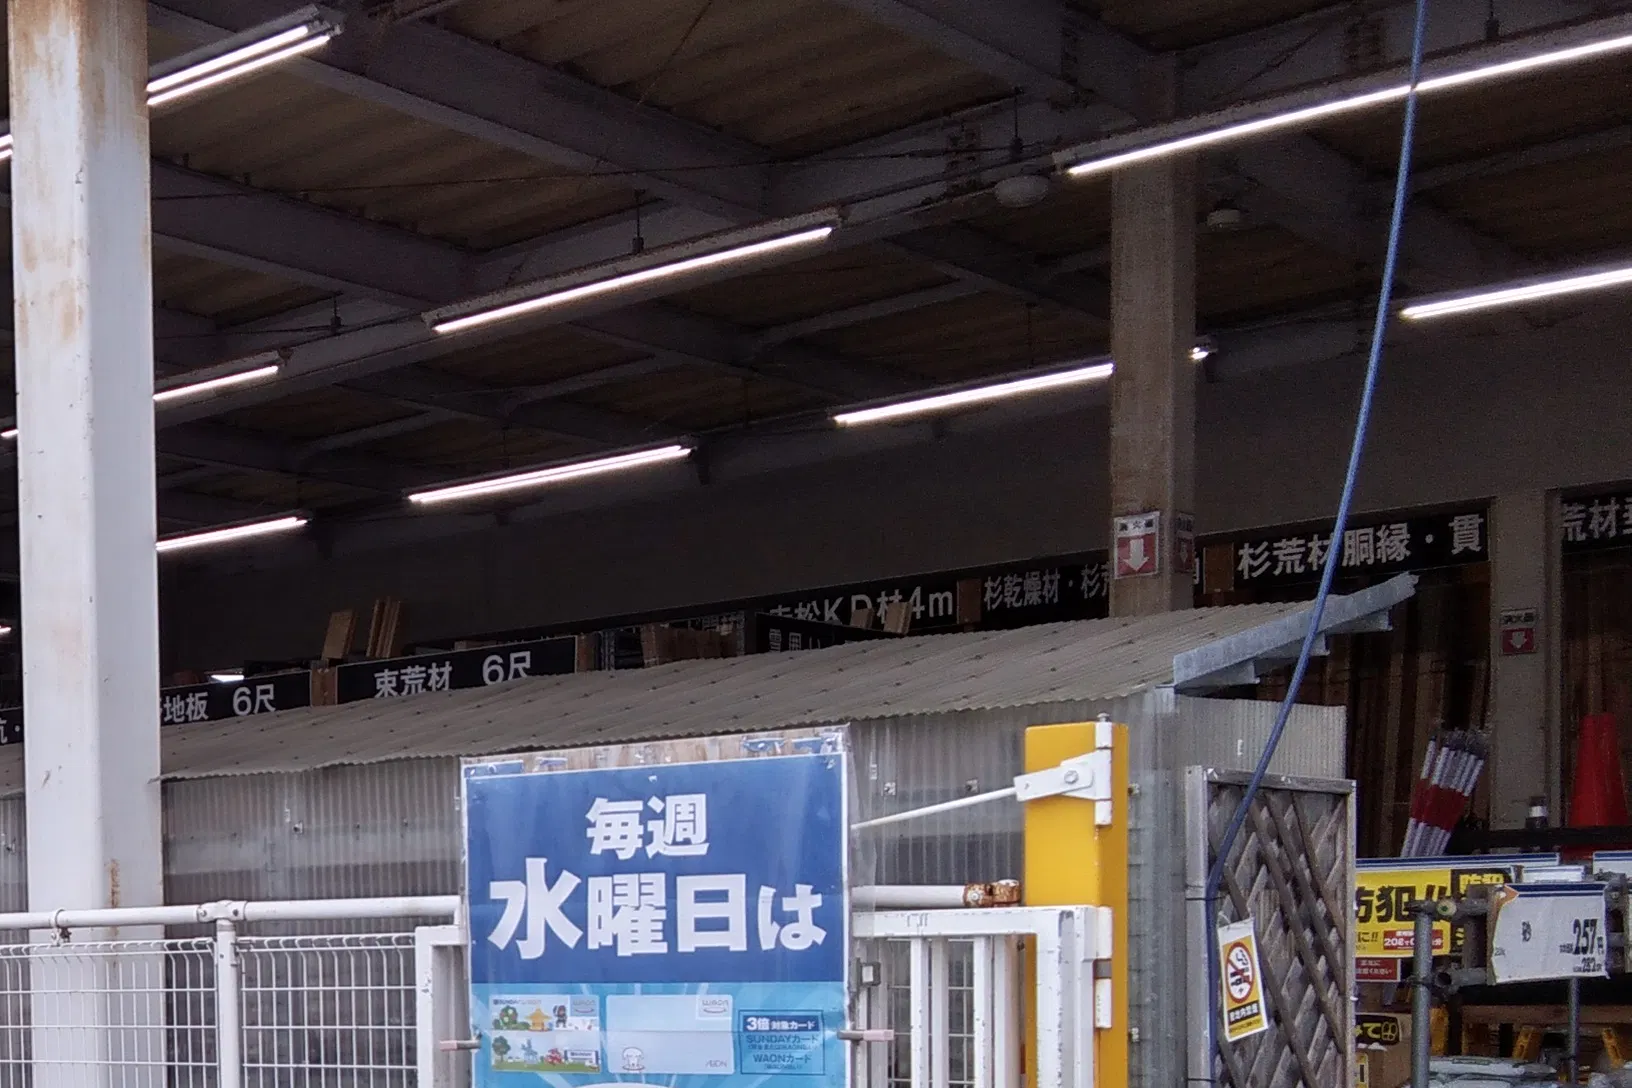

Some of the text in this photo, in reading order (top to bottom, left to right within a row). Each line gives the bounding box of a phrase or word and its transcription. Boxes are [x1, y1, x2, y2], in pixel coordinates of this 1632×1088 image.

[482, 651, 532, 684] 6尺
[160, 684, 276, 723] 地板 6尺
[586, 793, 709, 860] 毎週
[487, 857, 827, 960] 水曜日は
